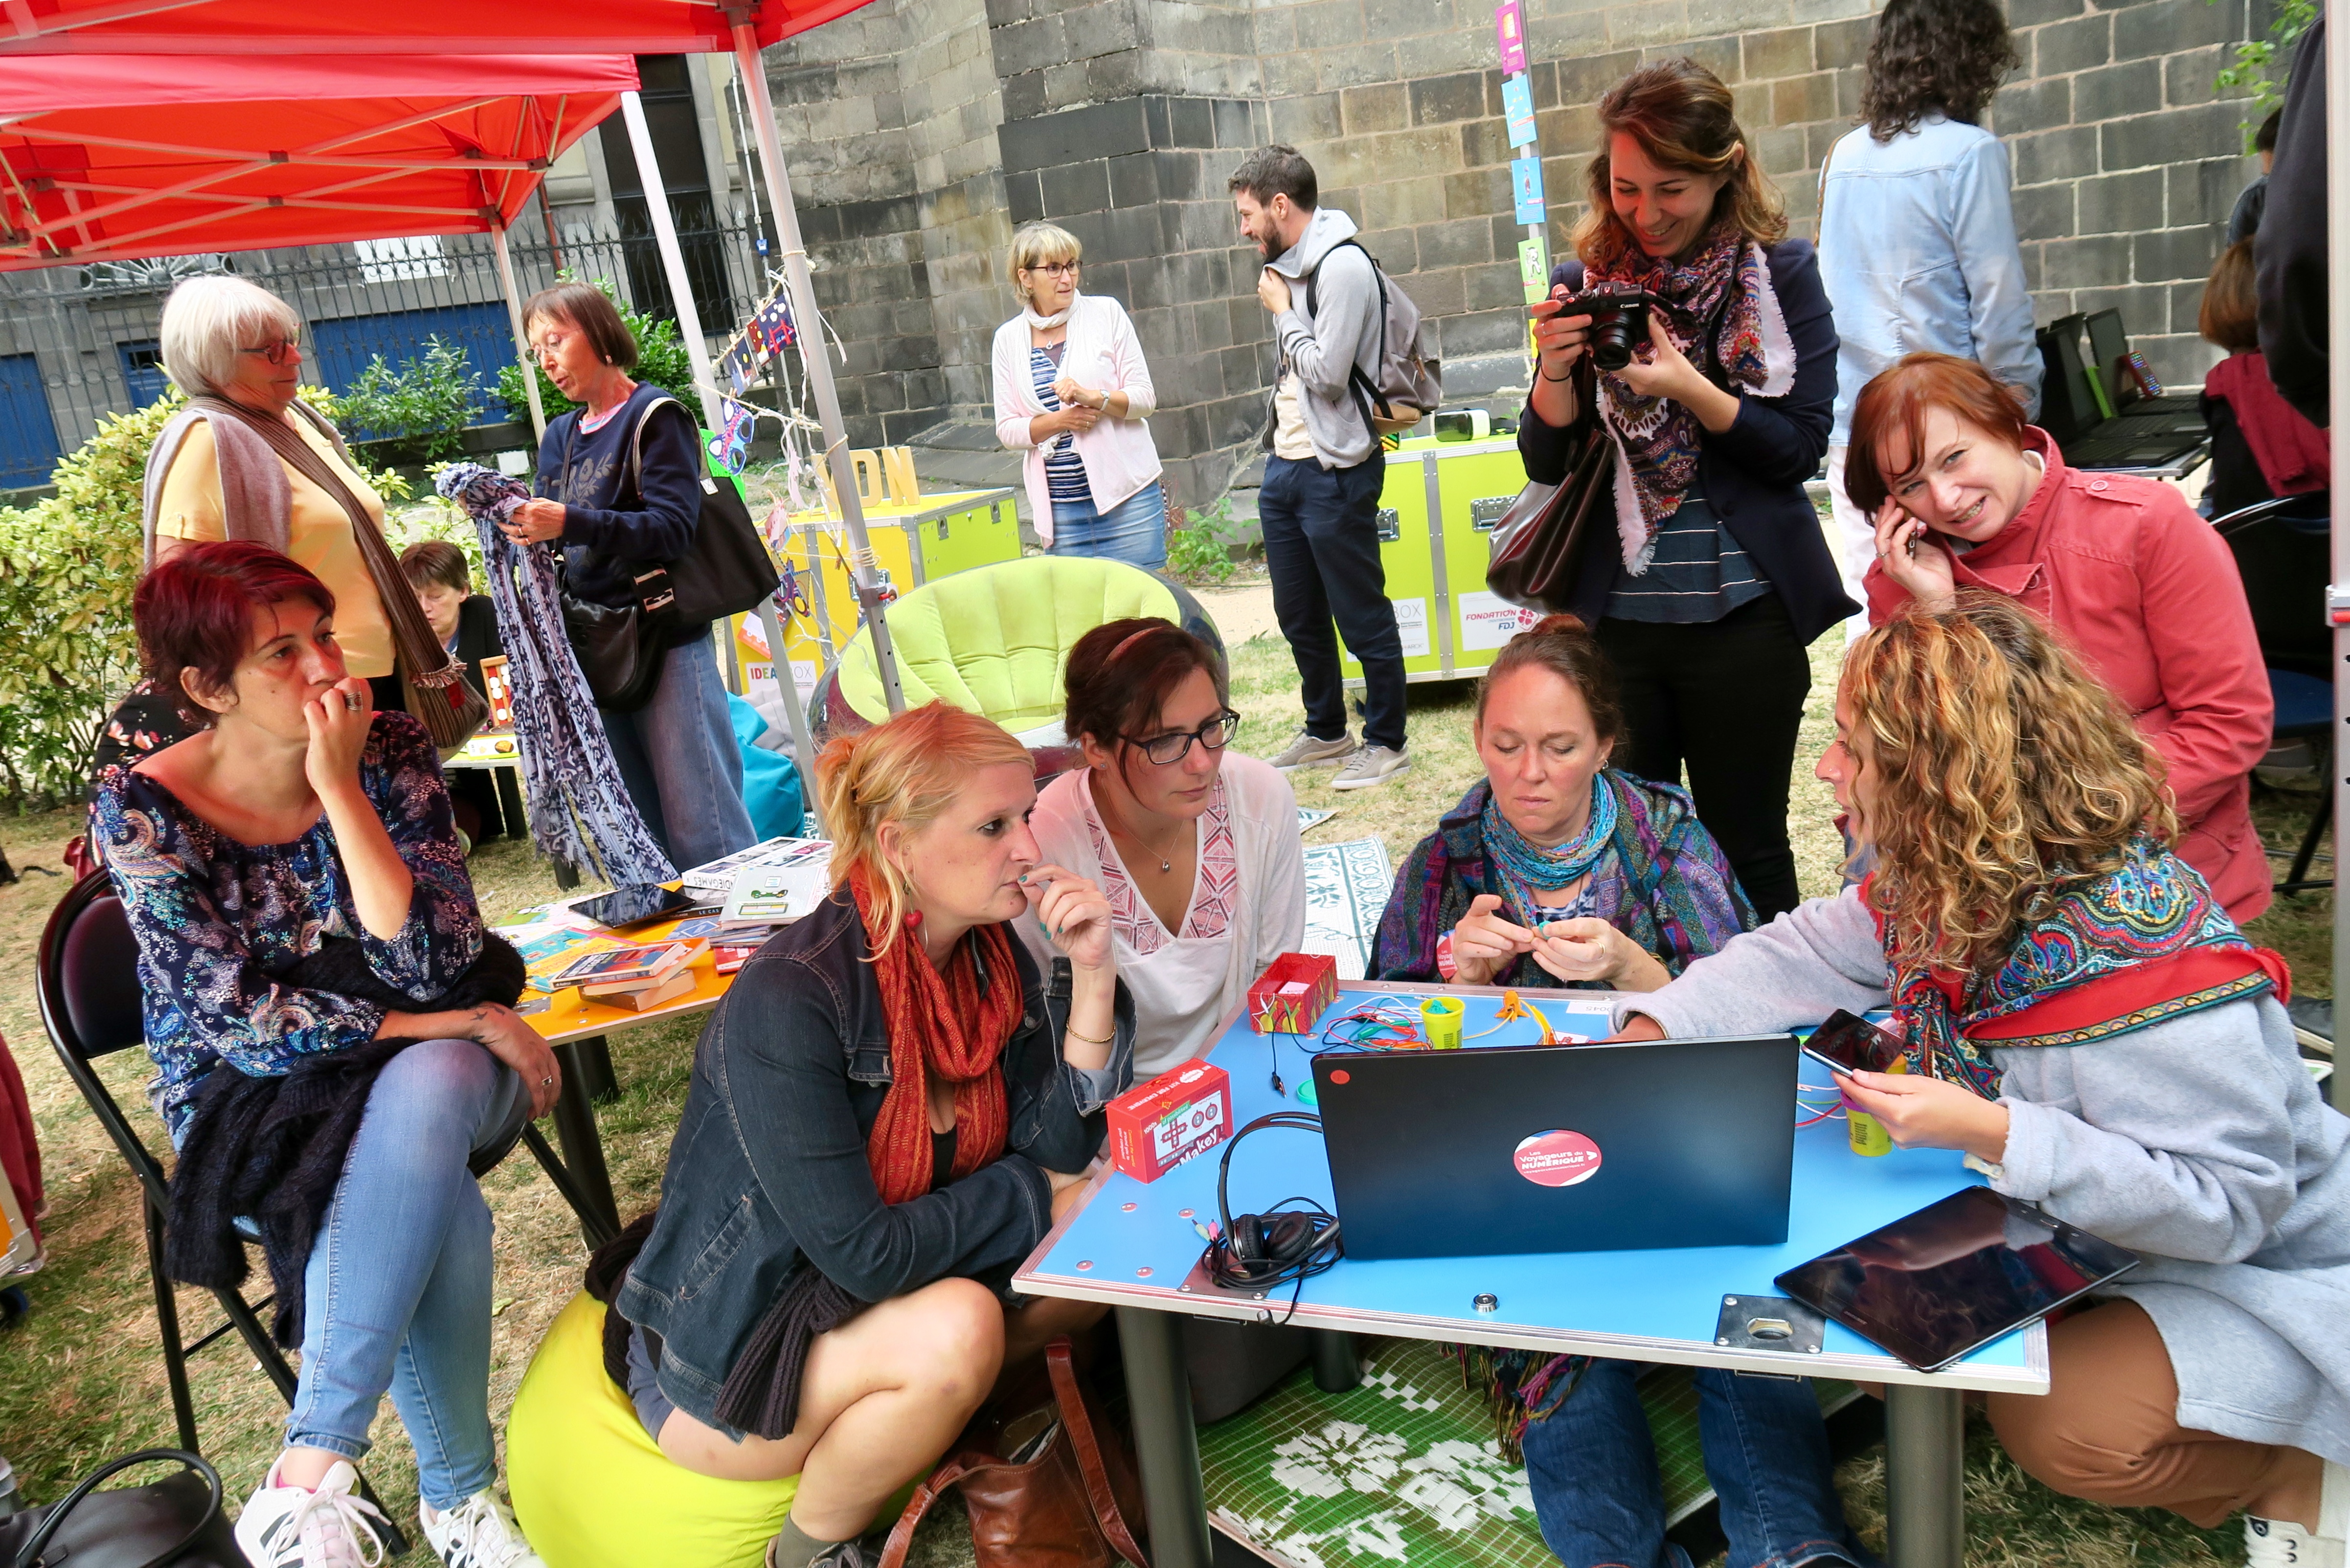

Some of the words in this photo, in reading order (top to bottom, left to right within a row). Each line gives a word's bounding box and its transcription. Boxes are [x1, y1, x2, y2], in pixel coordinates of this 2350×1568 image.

[1466, 609, 1516, 621] FONDATION
[1498, 622, 1515, 630] FDJ
[750, 668, 779, 679] IDEA
[794, 666, 812, 678] OX
[1144, 1121, 1157, 1134] 1000s
[1178, 1128, 1218, 1165] Makey
[1519, 1151, 1573, 1163] Voyageurs
